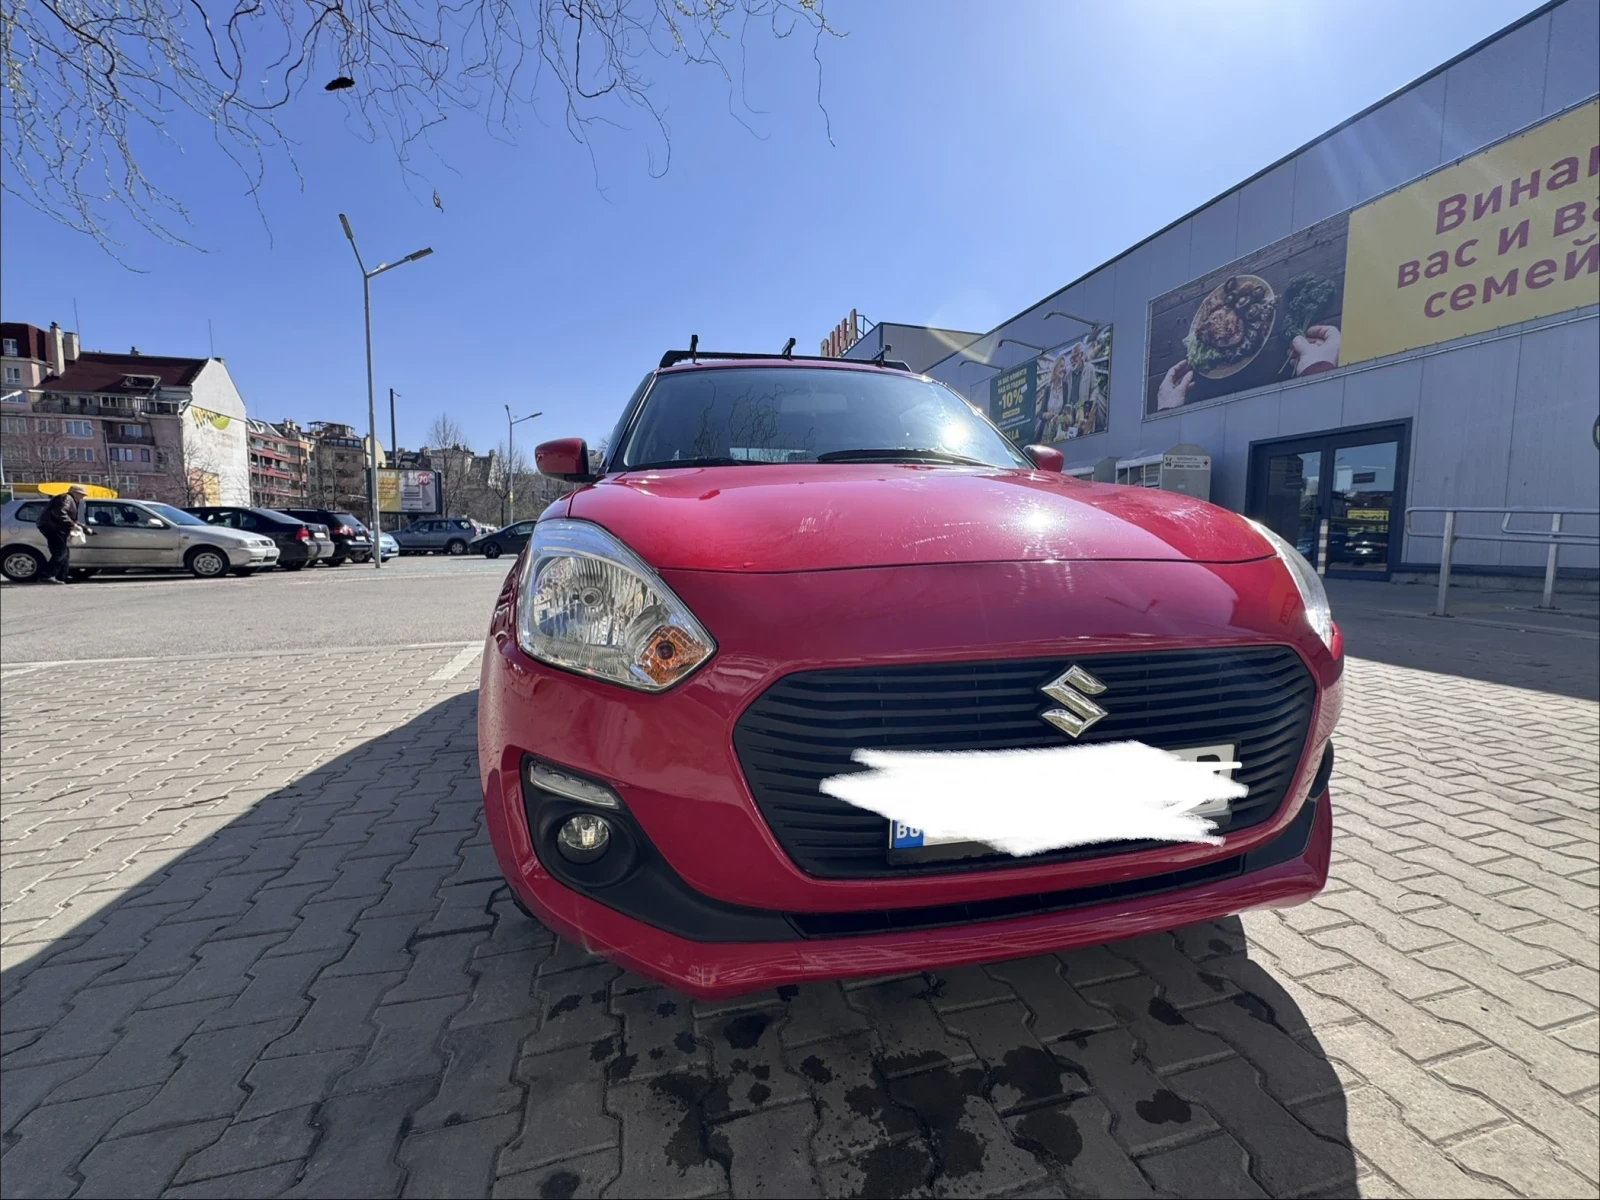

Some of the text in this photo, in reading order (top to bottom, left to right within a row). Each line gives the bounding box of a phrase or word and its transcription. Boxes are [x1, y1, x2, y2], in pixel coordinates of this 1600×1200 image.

[1397, 239, 1479, 288] вас
[1498, 219, 1530, 255] и
[1424, 233, 1599, 318] семей
[999, 389, 1023, 409] -10%
